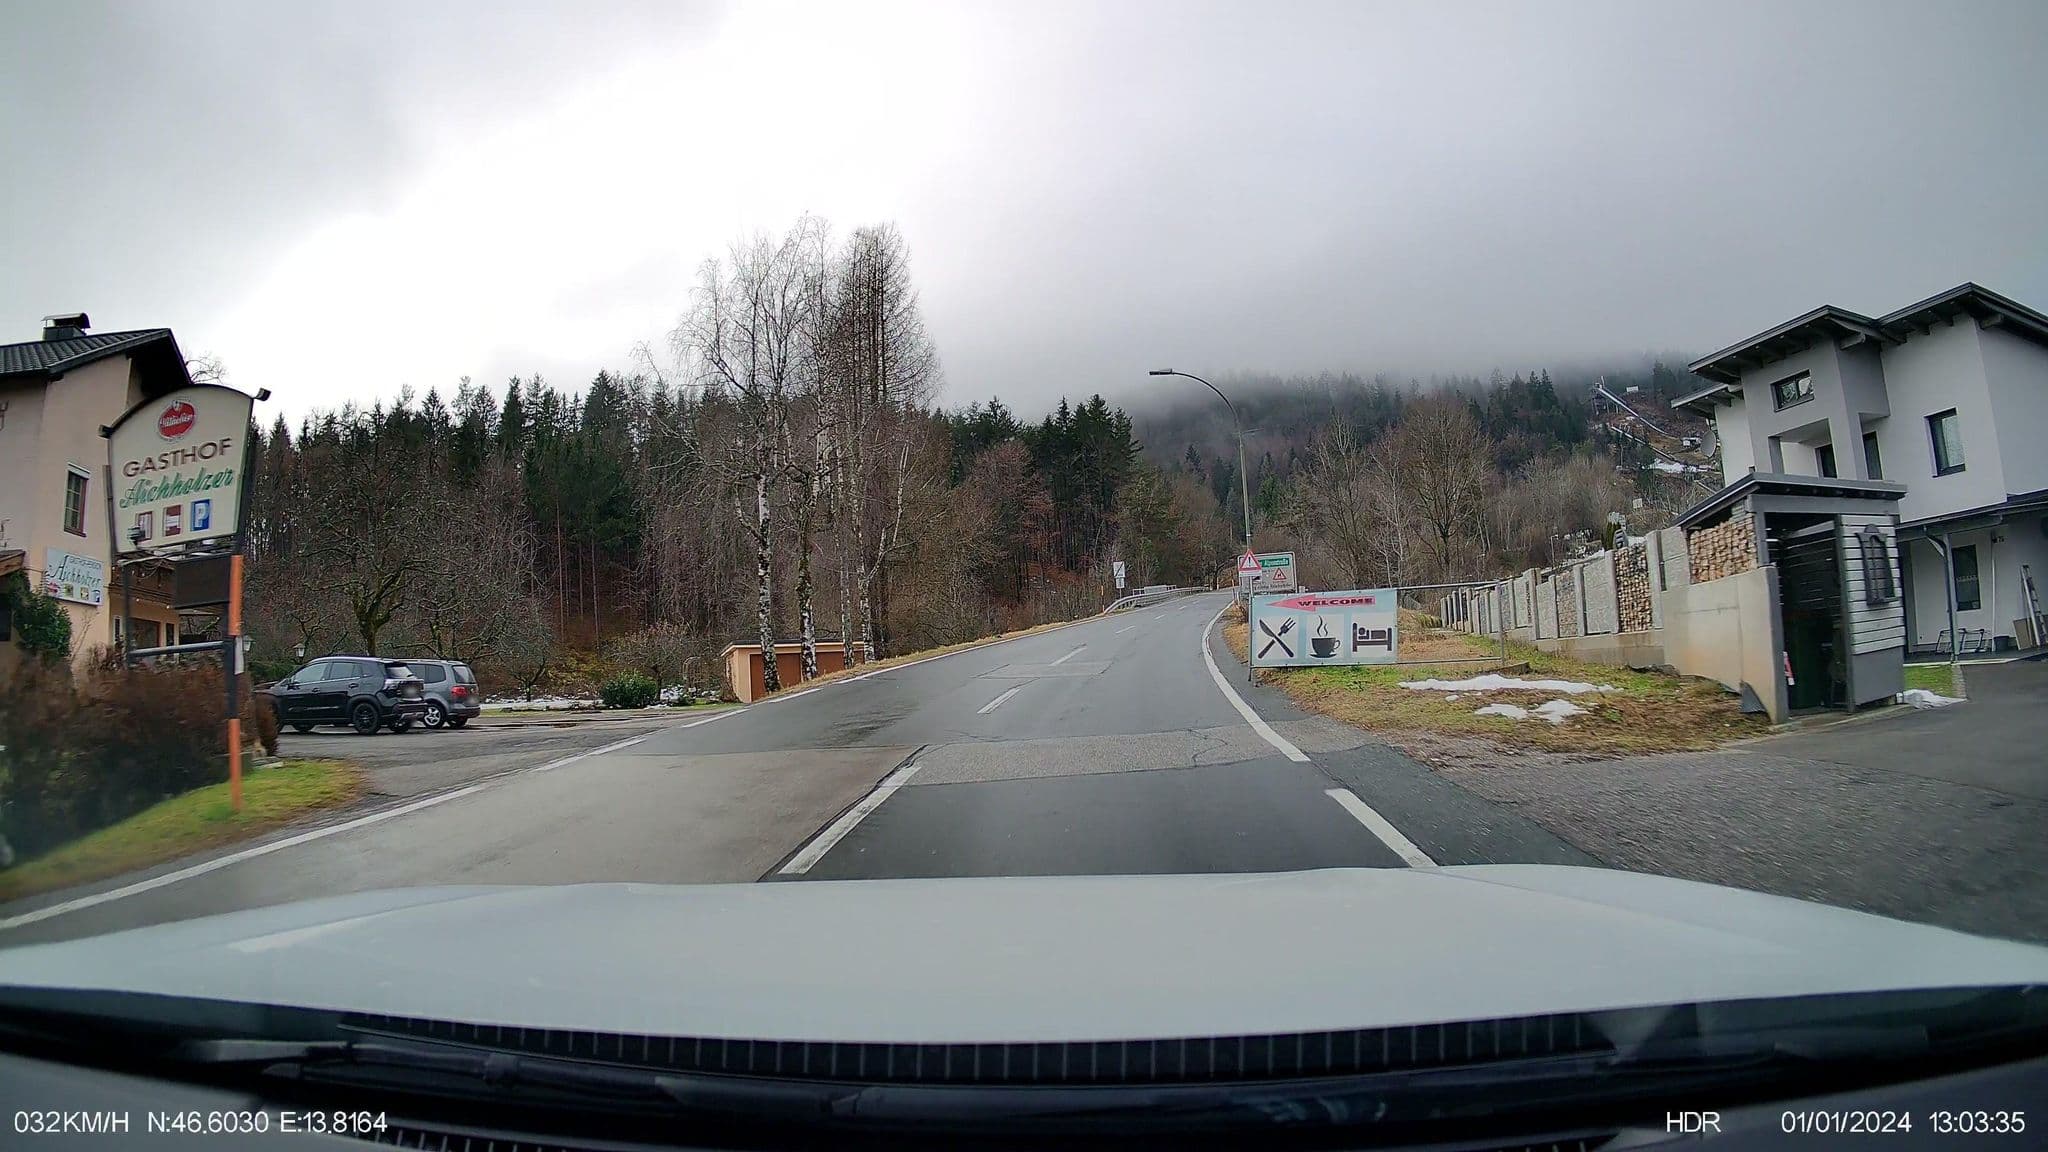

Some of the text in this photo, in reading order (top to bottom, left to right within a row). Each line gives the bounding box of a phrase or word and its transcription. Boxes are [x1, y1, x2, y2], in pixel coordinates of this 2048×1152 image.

[122, 438, 232, 477] GASTHOF
[119, 467, 234, 508] Aichholzer
[1298, 598, 1373, 606] WELCOME
